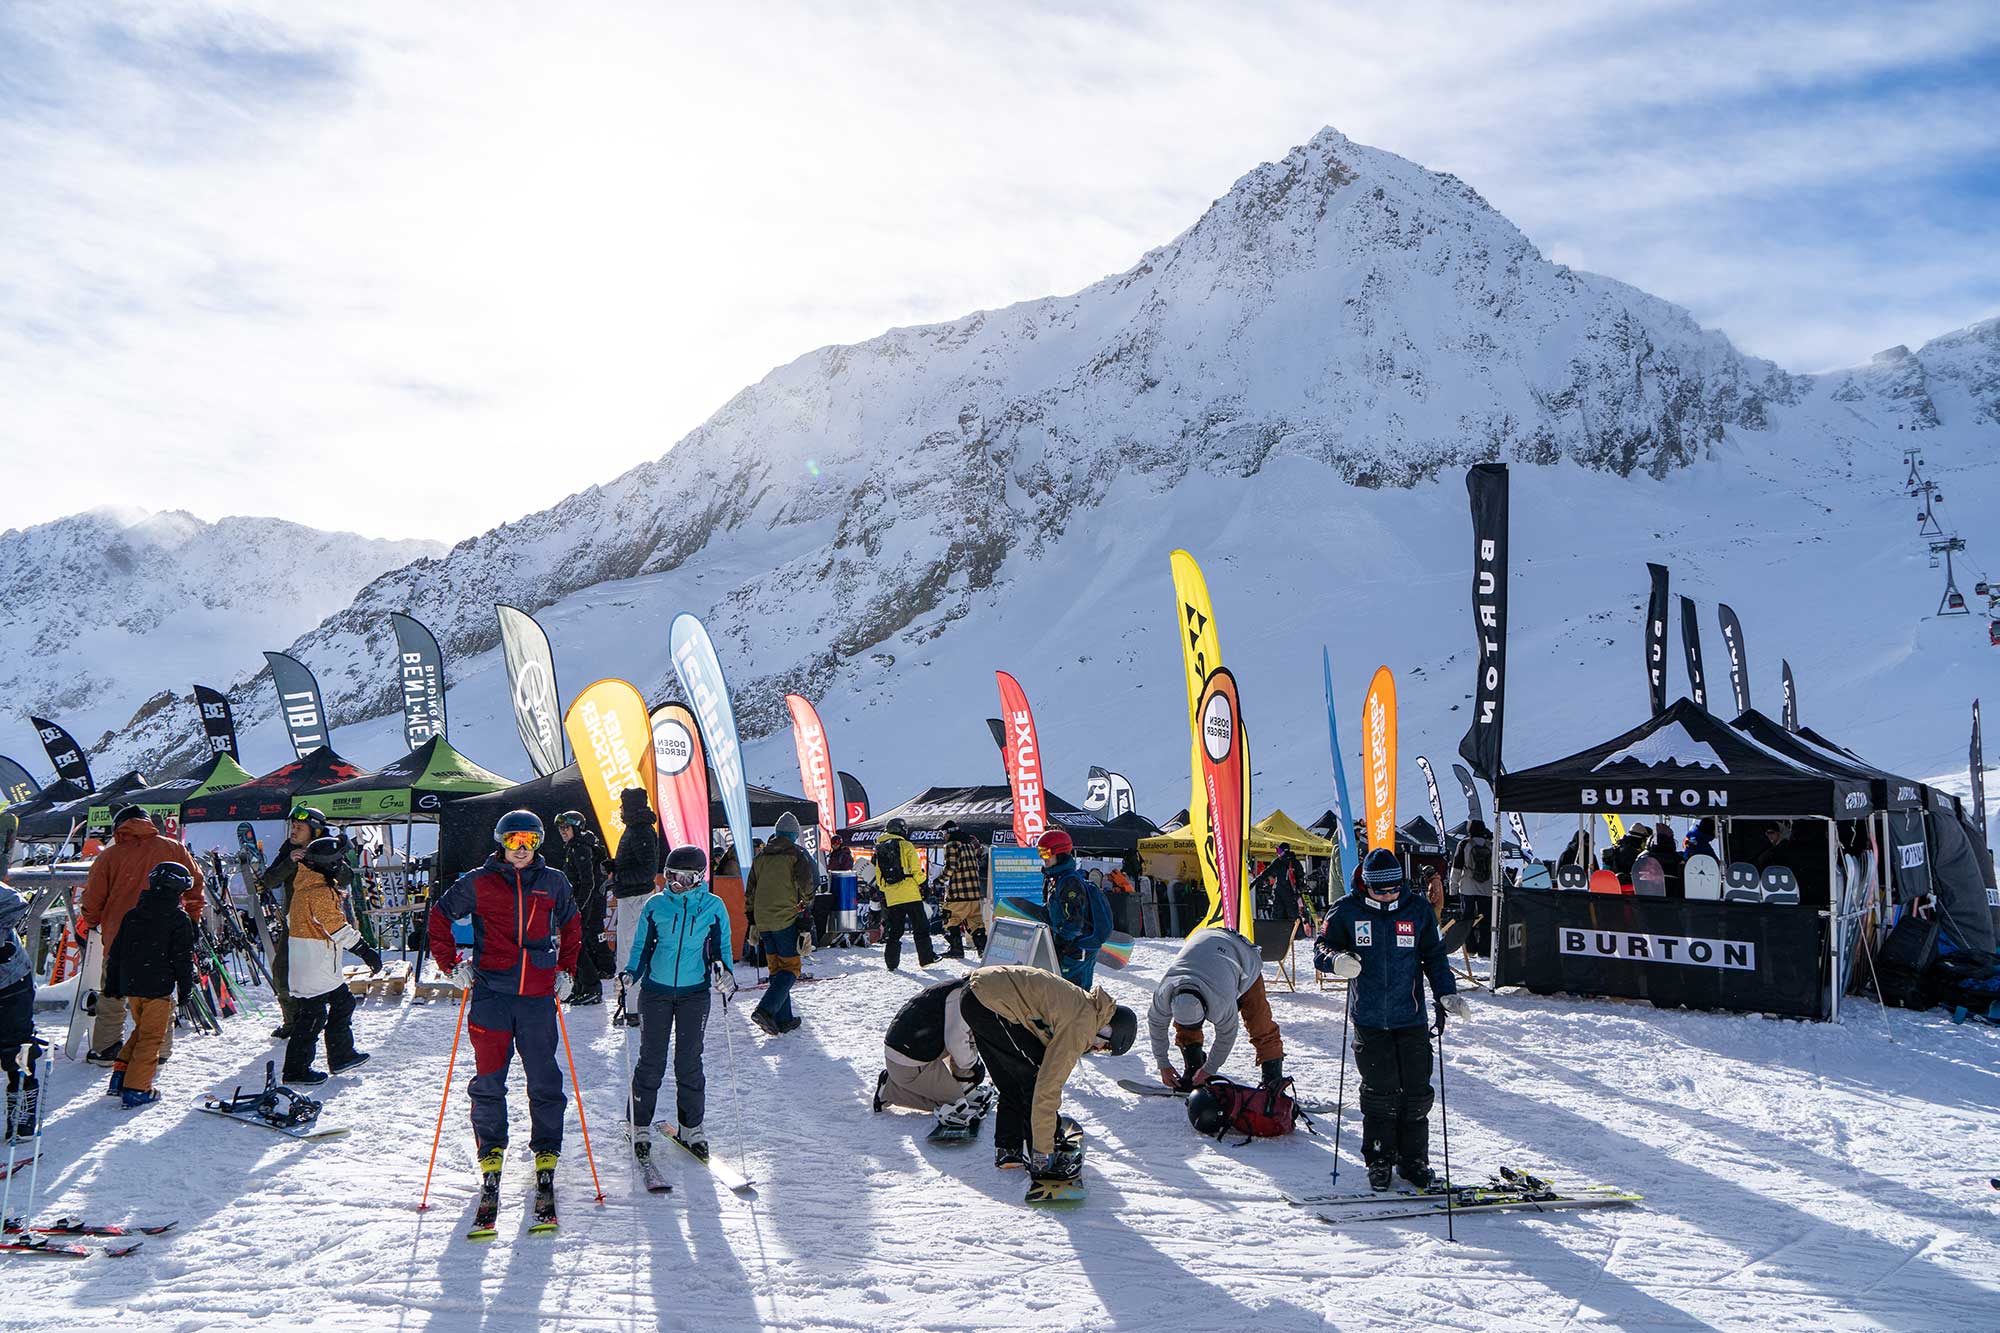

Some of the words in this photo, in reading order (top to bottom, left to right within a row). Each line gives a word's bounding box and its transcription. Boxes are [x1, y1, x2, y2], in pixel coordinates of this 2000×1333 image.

[202, 702, 226, 719] DC
[210, 735, 232, 752] DC
[54, 749, 80, 769] DC
[1581, 788, 1728, 807] BURTON
[1398, 924, 1411, 932] HH
[1357, 936, 1370, 944] 5G
[1566, 931, 1748, 967] BURTON
